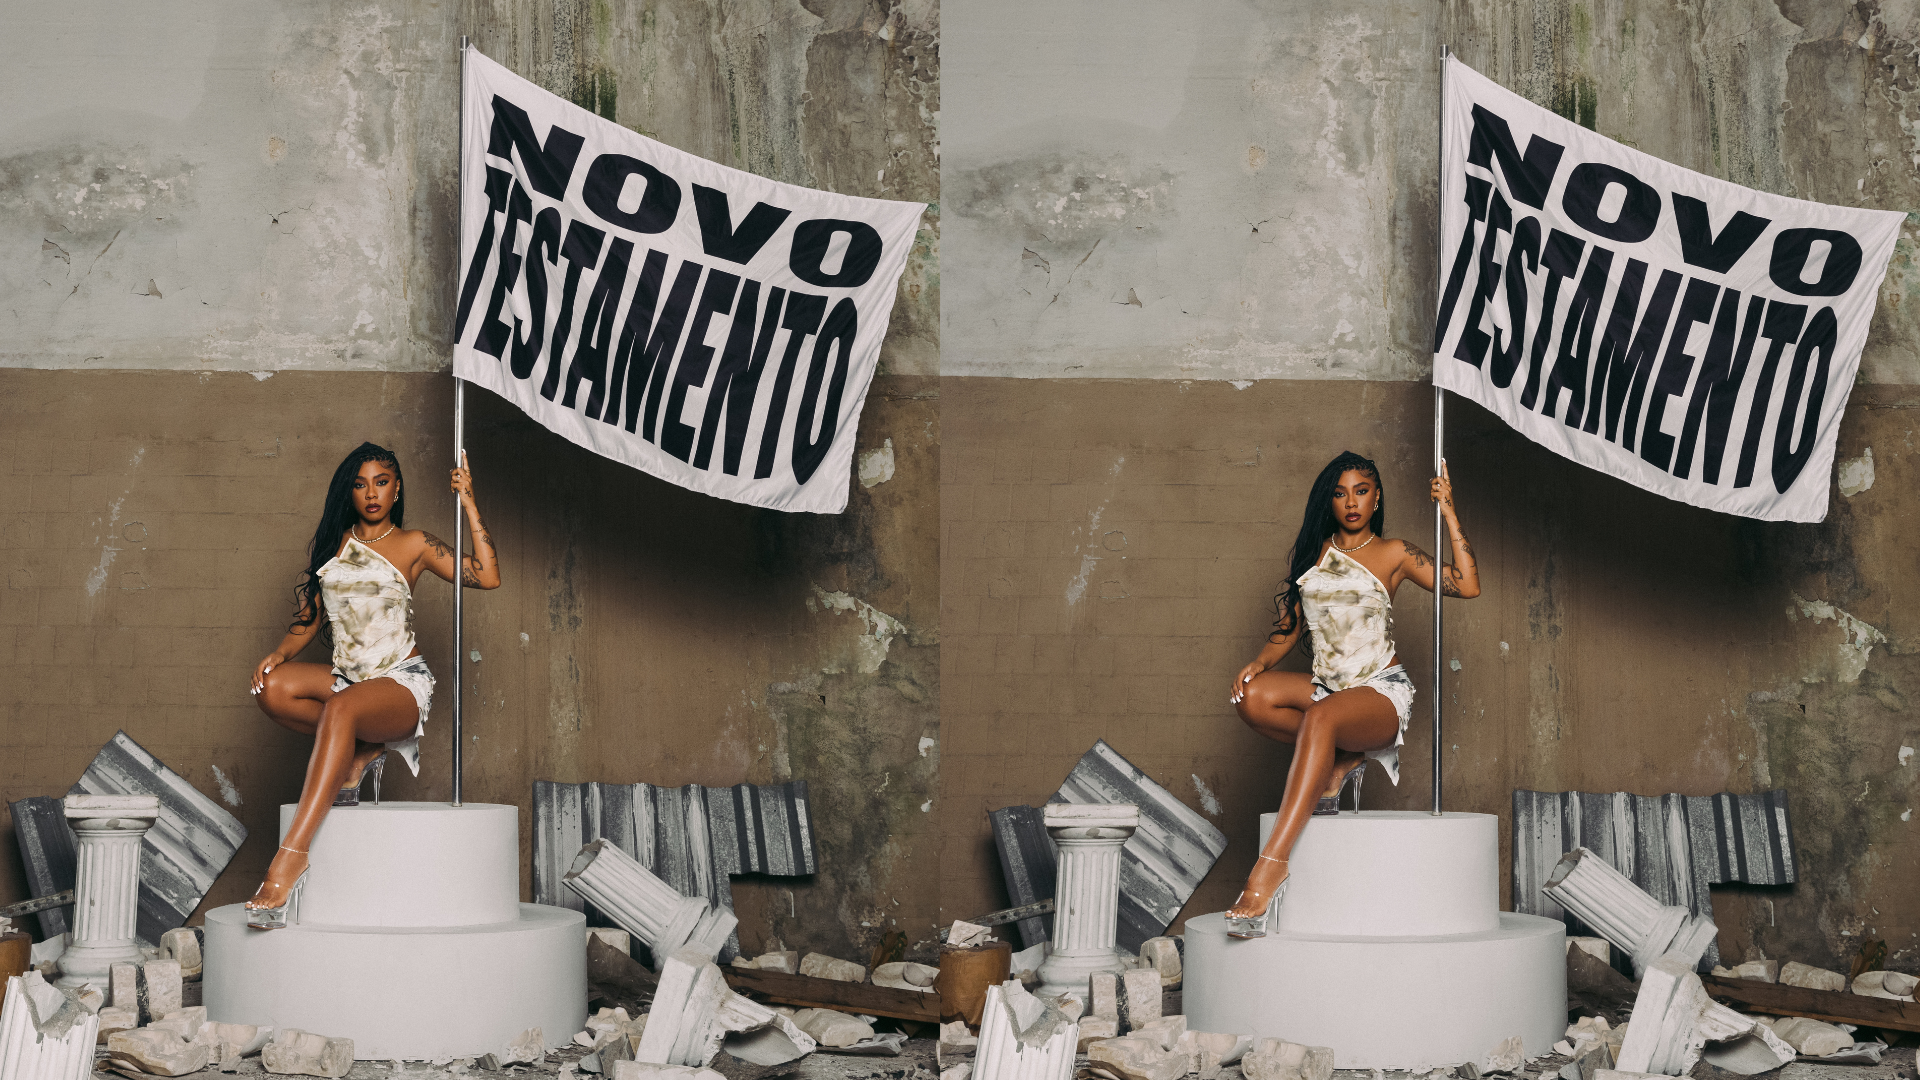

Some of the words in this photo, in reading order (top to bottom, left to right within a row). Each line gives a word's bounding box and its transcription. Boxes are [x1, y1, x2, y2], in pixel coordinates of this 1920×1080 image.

[487, 93, 883, 288] NOVO
[1467, 102, 1863, 297] NOVO
[454, 163, 858, 486] TESTAMENTO
[1434, 172, 1838, 495] TESTAMENTO
